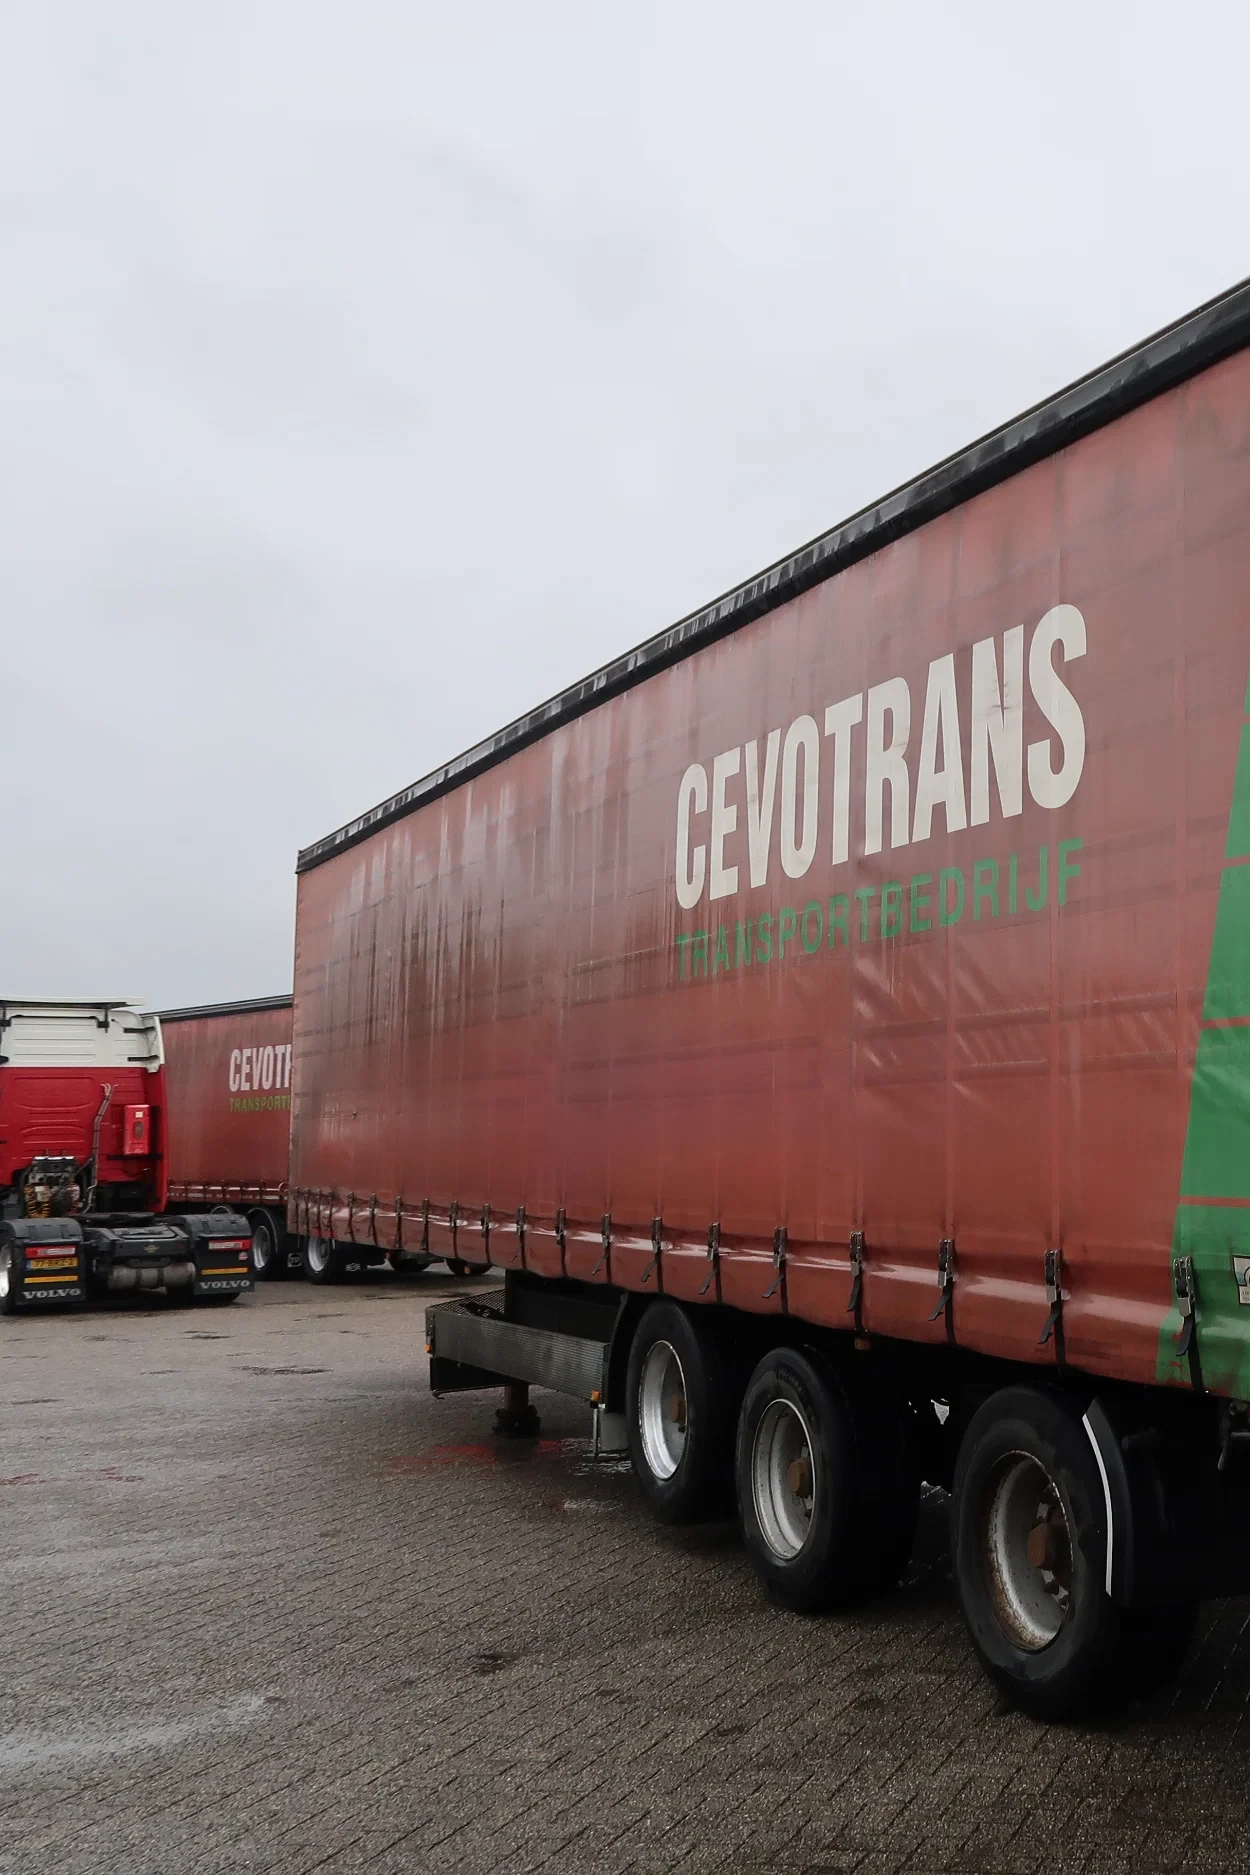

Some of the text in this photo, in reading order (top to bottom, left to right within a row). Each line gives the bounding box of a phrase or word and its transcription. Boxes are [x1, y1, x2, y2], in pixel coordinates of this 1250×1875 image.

[676, 604, 1087, 909] CEVOTRANS
[675, 837, 1083, 979] TRANSPORTBEDRIJF
[22, 1287, 80, 1299] VOLVO
[199, 1279, 250, 1290] VOLVO
